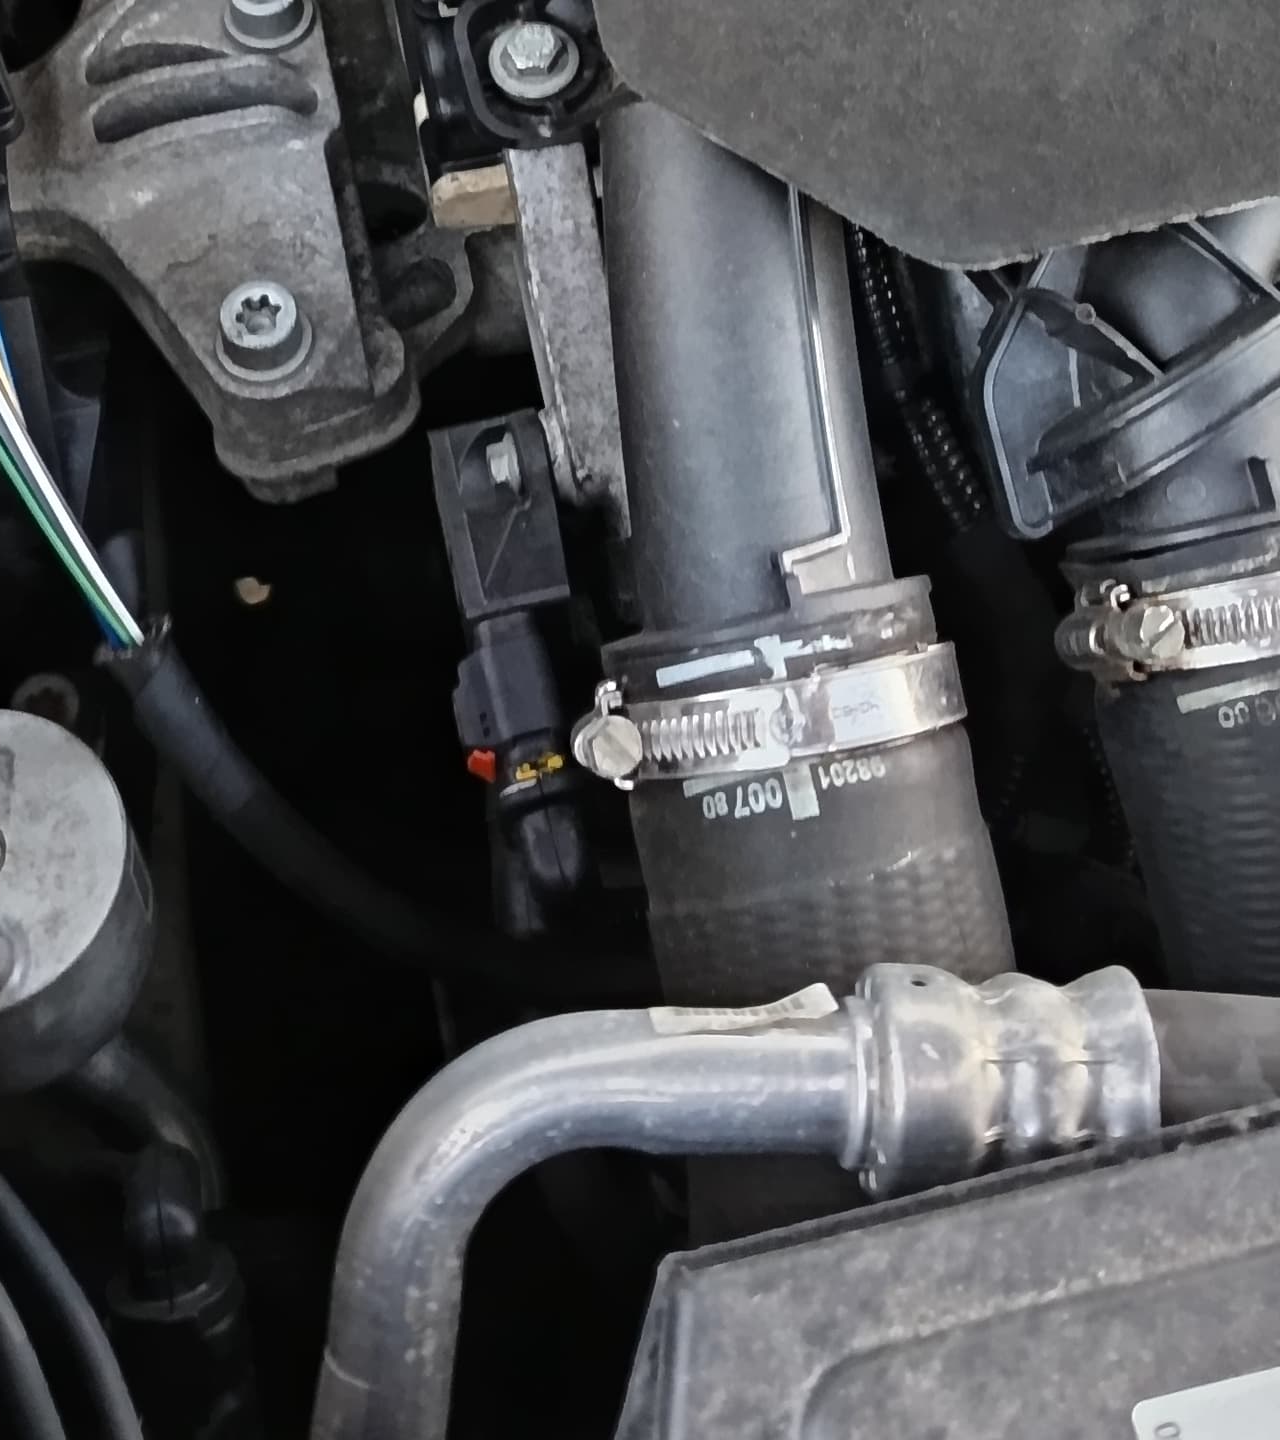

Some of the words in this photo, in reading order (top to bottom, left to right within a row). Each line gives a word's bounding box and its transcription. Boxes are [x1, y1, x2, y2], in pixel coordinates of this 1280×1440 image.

[818, 756, 887, 790] 98201
[702, 791, 729, 820] 80
[734, 778, 783, 819] 007
